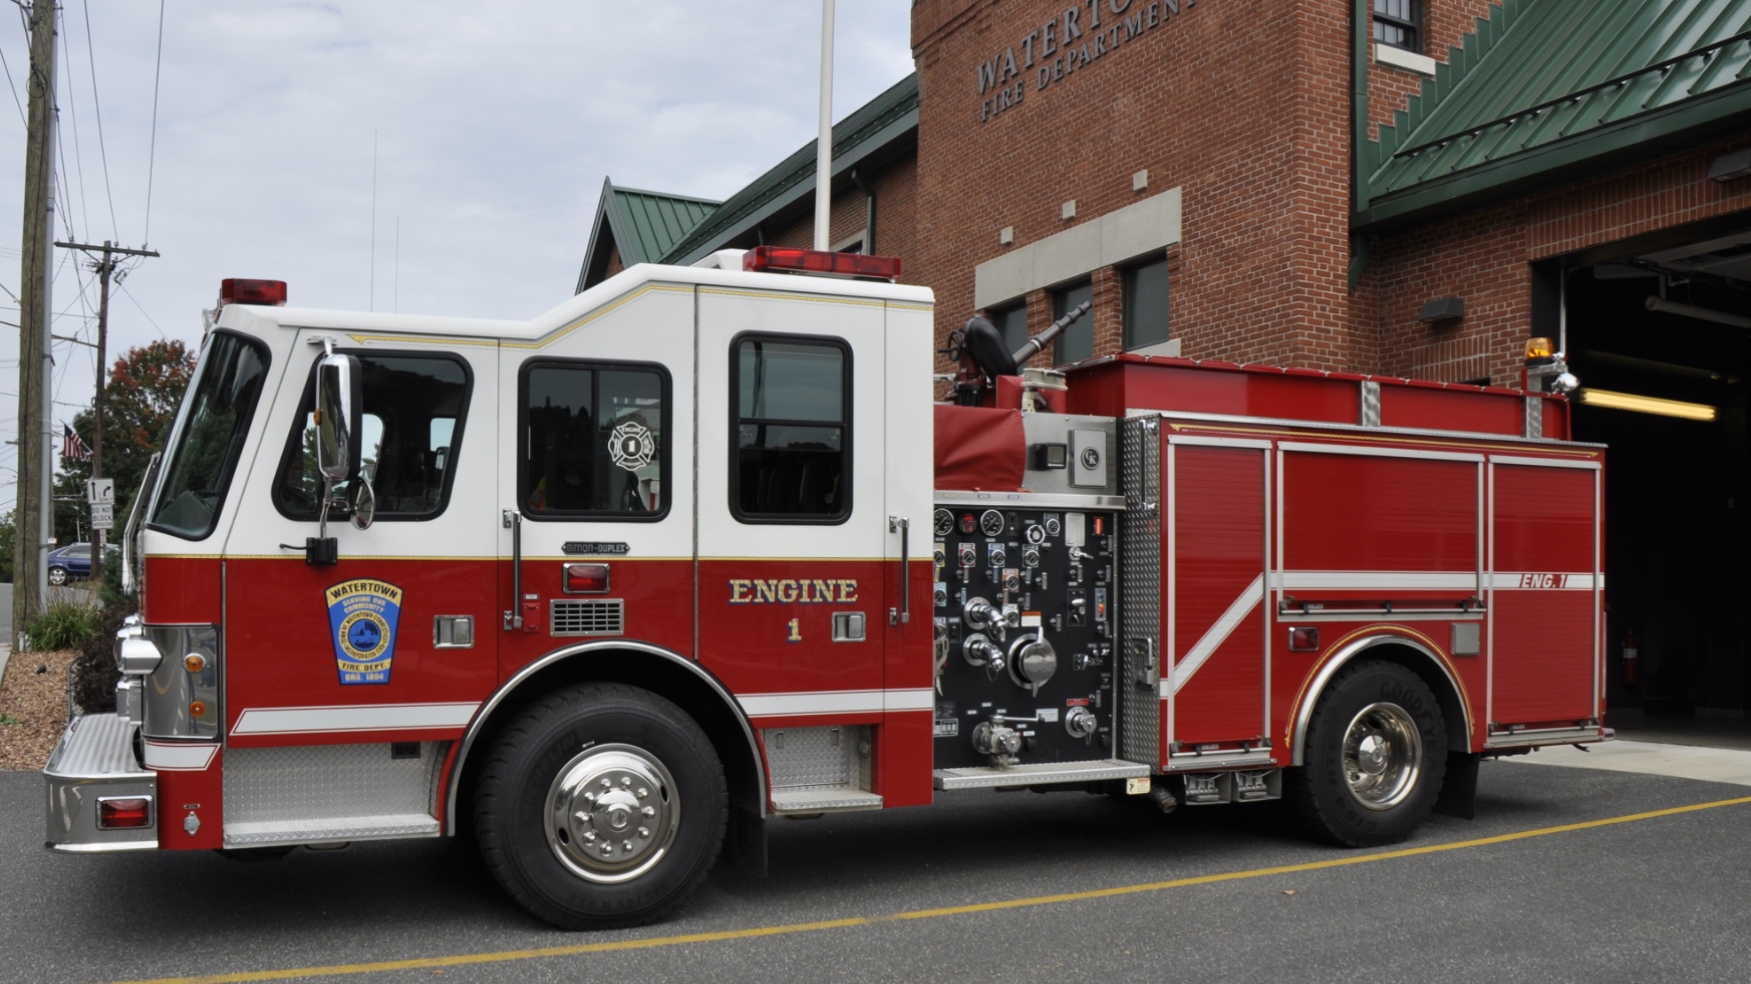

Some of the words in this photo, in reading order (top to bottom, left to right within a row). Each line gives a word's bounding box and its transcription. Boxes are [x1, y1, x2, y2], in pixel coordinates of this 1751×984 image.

[981, 79, 1025, 122] FIRE
[628, 440, 635, 452] 1
[1521, 574, 1557, 588] ENG.
[1559, 574, 1566, 588] 1
[331, 582, 398, 599] WATERTOWN
[728, 579, 858, 604] ENGINE
[344, 603, 385, 614] COMMUNITY
[786, 618, 802, 643] 1
[342, 662, 359, 670] FIRE
